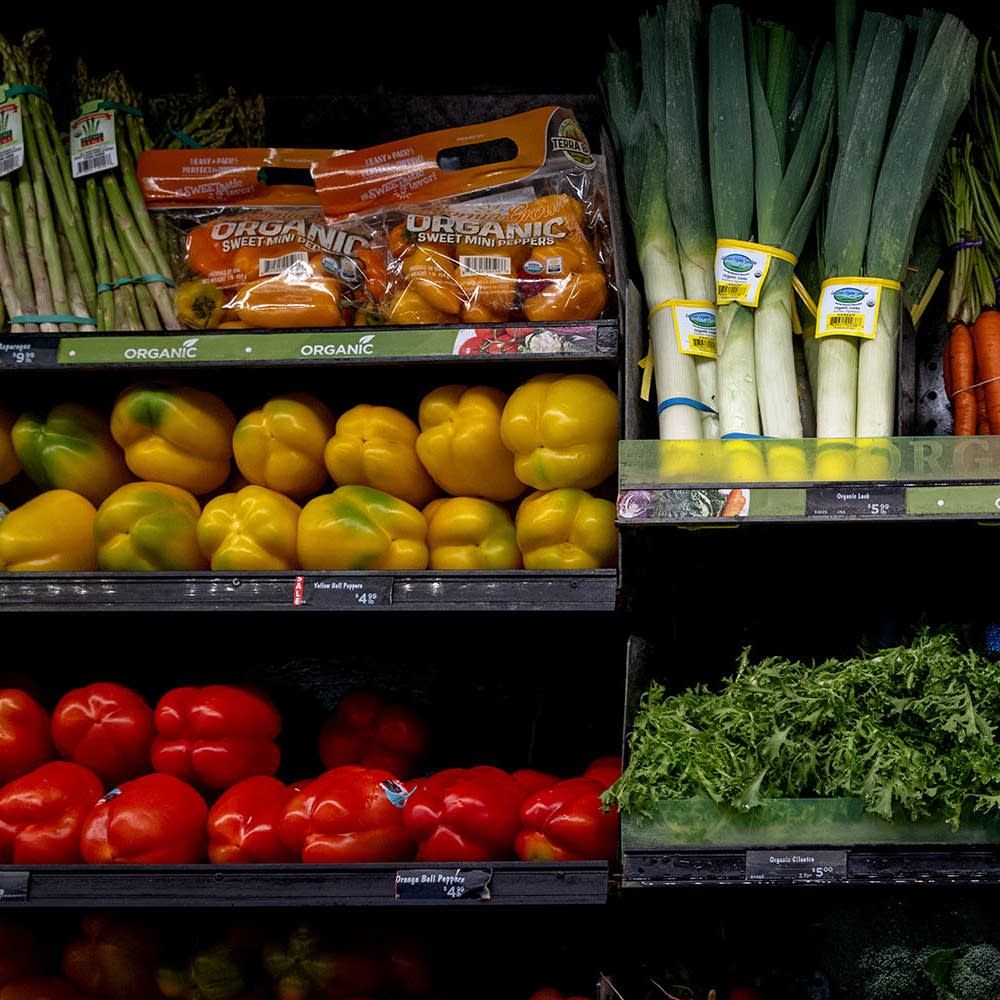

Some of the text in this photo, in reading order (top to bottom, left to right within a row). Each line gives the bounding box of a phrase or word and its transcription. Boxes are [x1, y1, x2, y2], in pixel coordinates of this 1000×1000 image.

[407, 213, 568, 241] ORGANIC
[210, 219, 370, 257] ORGANIC
[222, 235, 264, 253] SWEET
[266, 233, 295, 247] MINI
[417, 232, 556, 248] SWEET MINI PEPPERS
[124, 347, 197, 359] ORGANIC
[300, 343, 374, 356] ORGANIC
[343, 582, 363, 590] Peppers
[396, 874, 465, 885] Orange Bell Peppers
